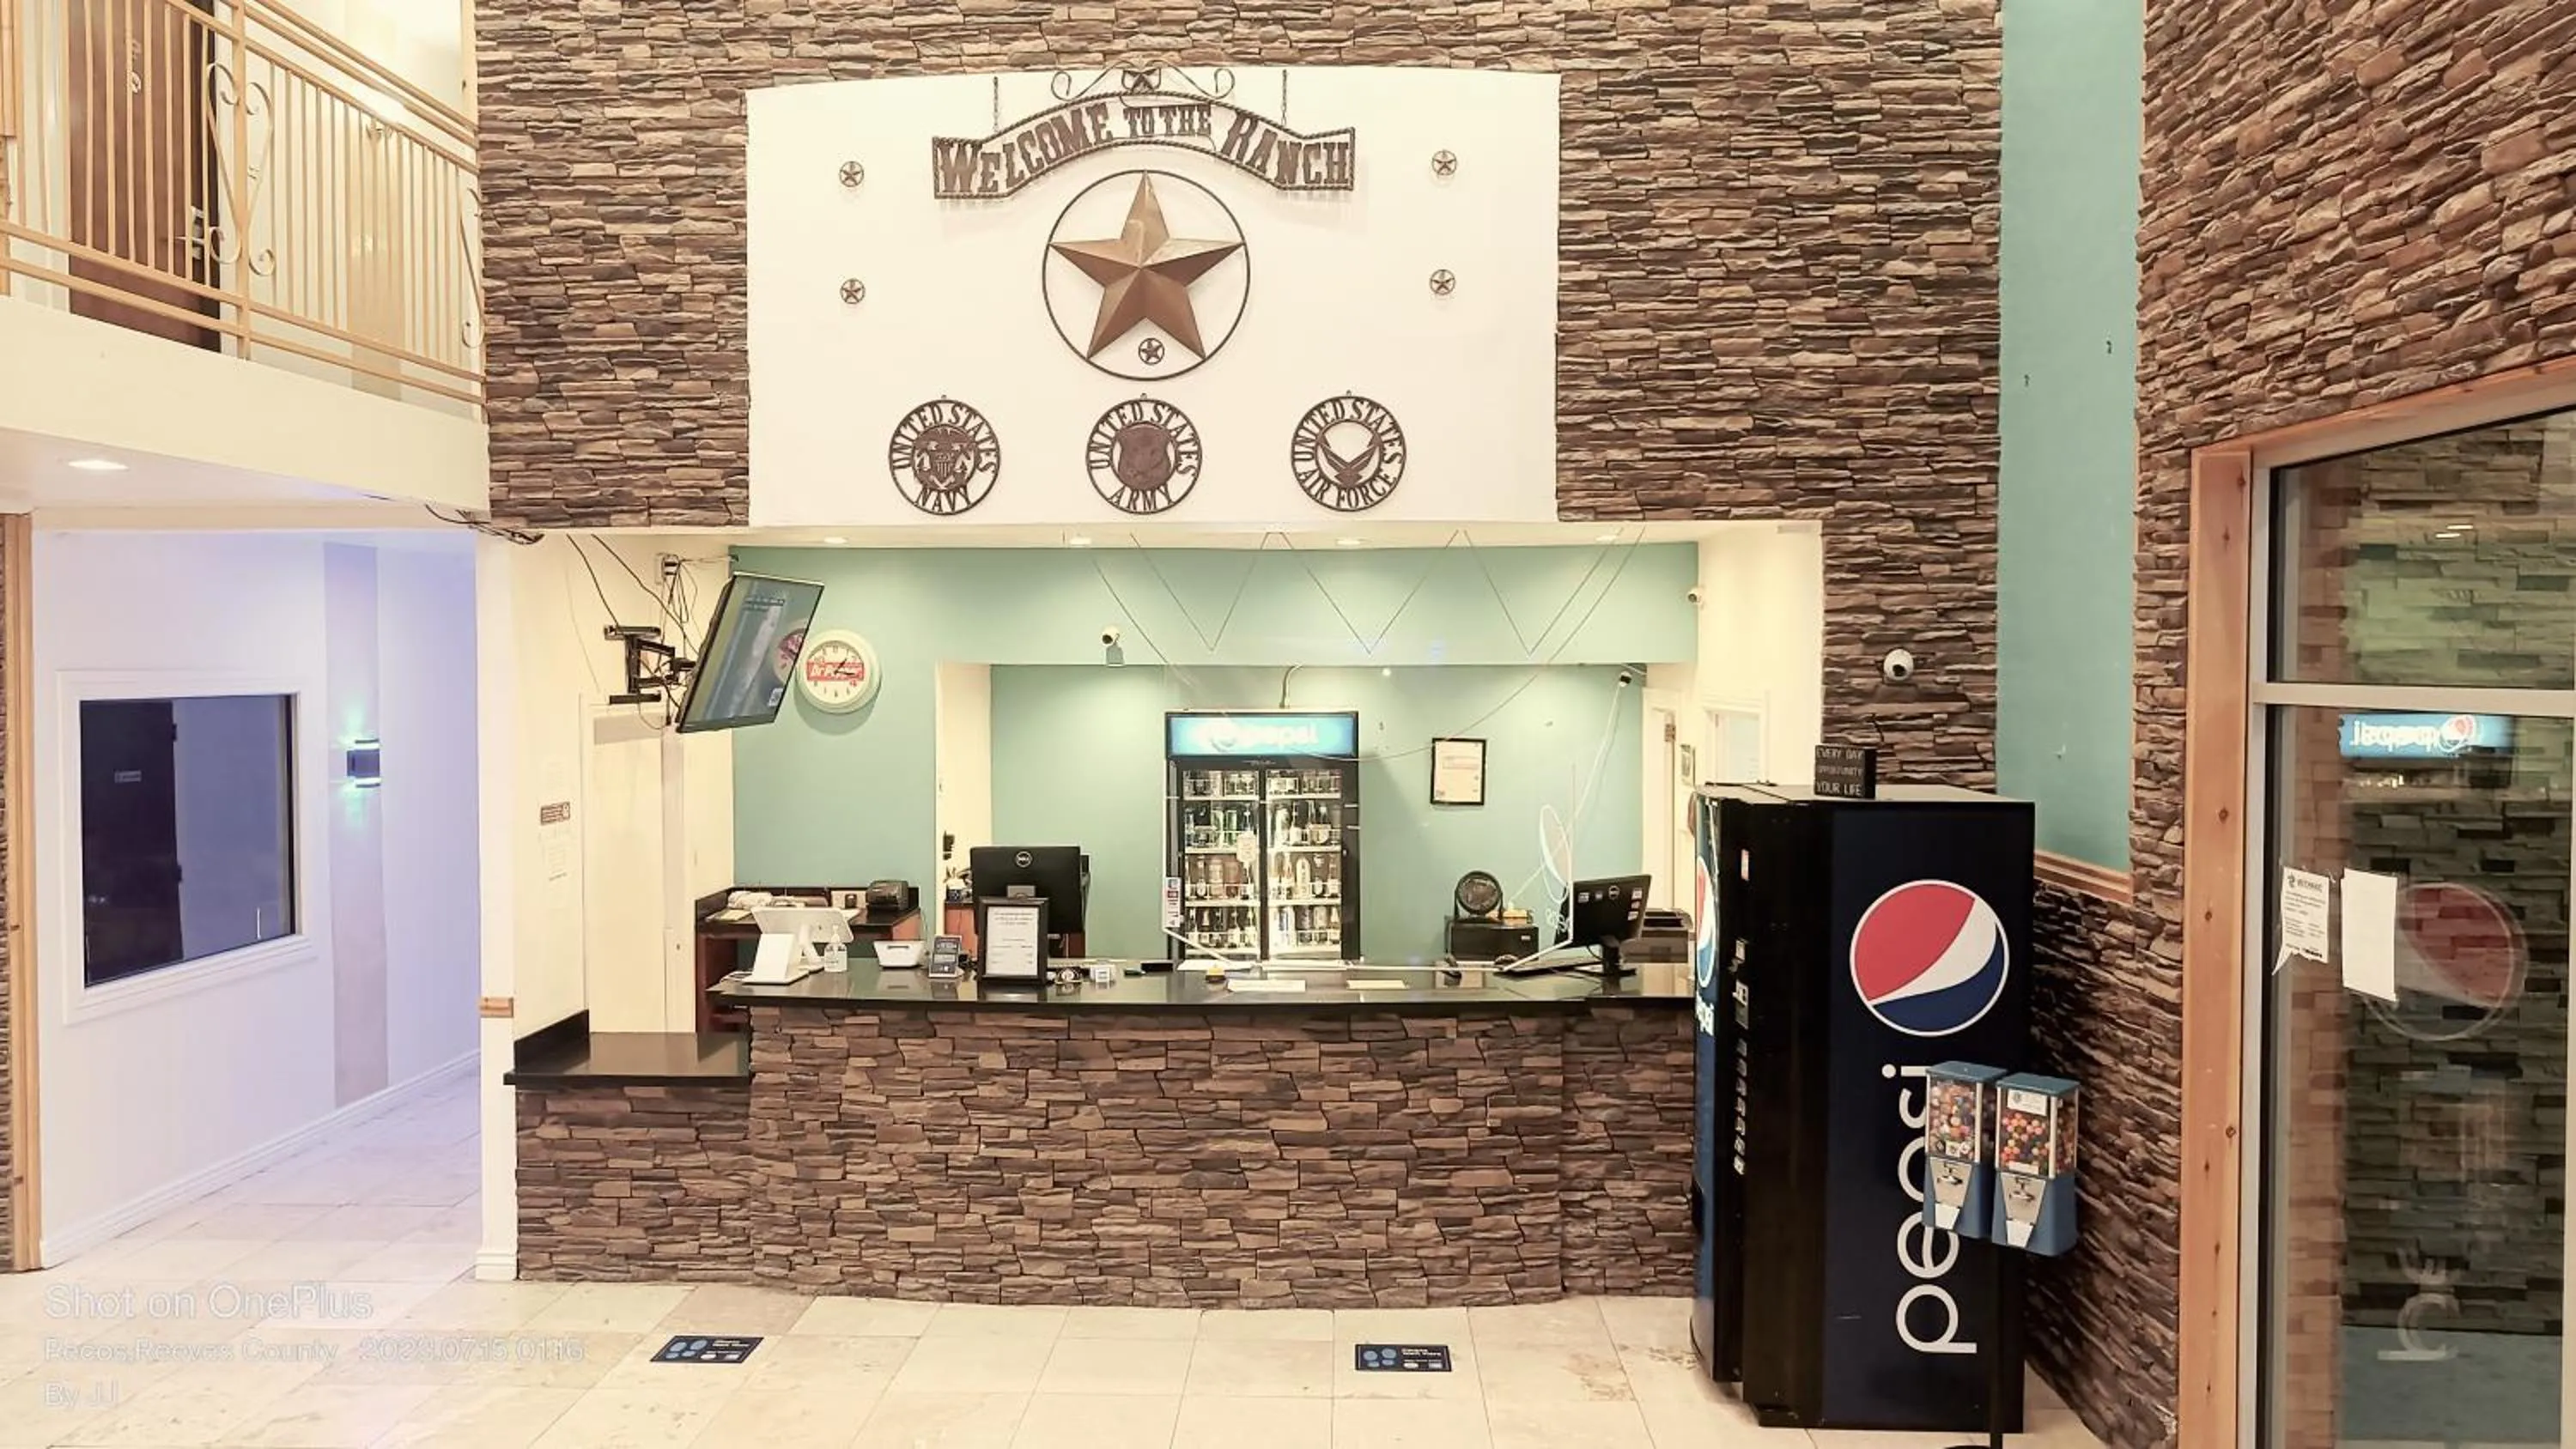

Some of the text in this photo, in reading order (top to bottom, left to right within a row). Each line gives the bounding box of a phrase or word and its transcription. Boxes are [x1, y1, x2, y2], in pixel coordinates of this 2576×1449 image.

[938, 102, 1350, 193] WELCOME TO THE RANCH
[891, 403, 999, 473] UNITED STATES
[1087, 400, 1200, 477] UNITED STATES
[1291, 397, 1403, 464] UNITED STATES
[913, 485, 971, 513] NAVY
[1107, 482, 1174, 512] ARMY
[1297, 467, 1399, 508] AIR FORCE
